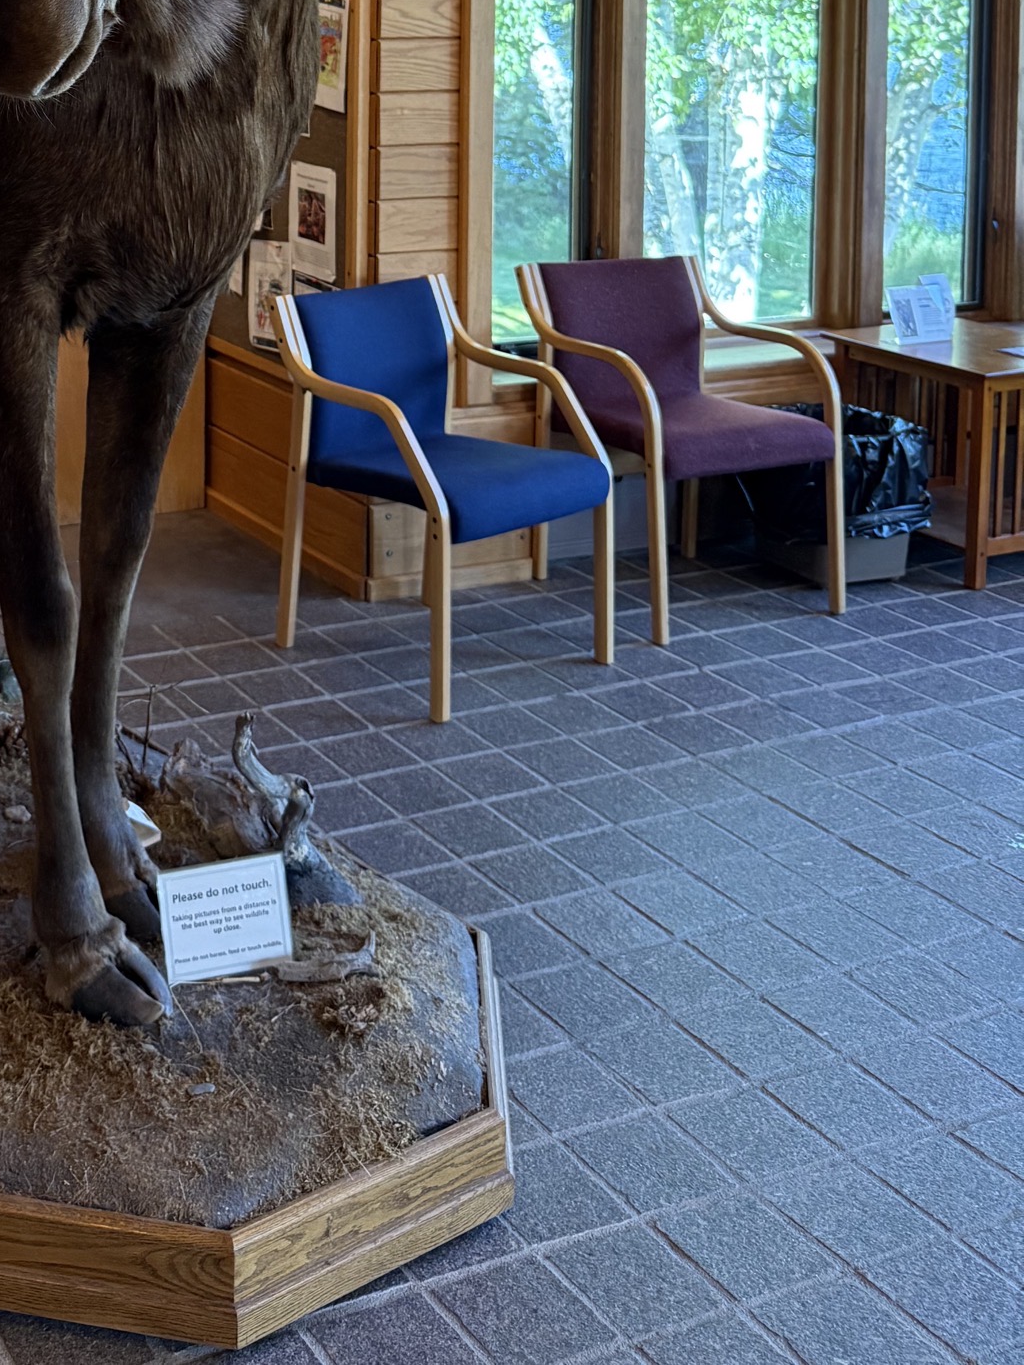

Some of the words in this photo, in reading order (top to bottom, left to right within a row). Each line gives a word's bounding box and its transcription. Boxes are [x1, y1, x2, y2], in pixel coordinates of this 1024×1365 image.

[172, 892, 203, 904] Please
[206, 887, 219, 898] do
[222, 884, 239, 895] not
[241, 878, 272, 891] touch.
[172, 913, 193, 922] Taking
[194, 909, 220, 919] pictures
[243, 901, 270, 909] distance
[271, 897, 277, 905] is
[245, 909, 269, 918] wildlife
